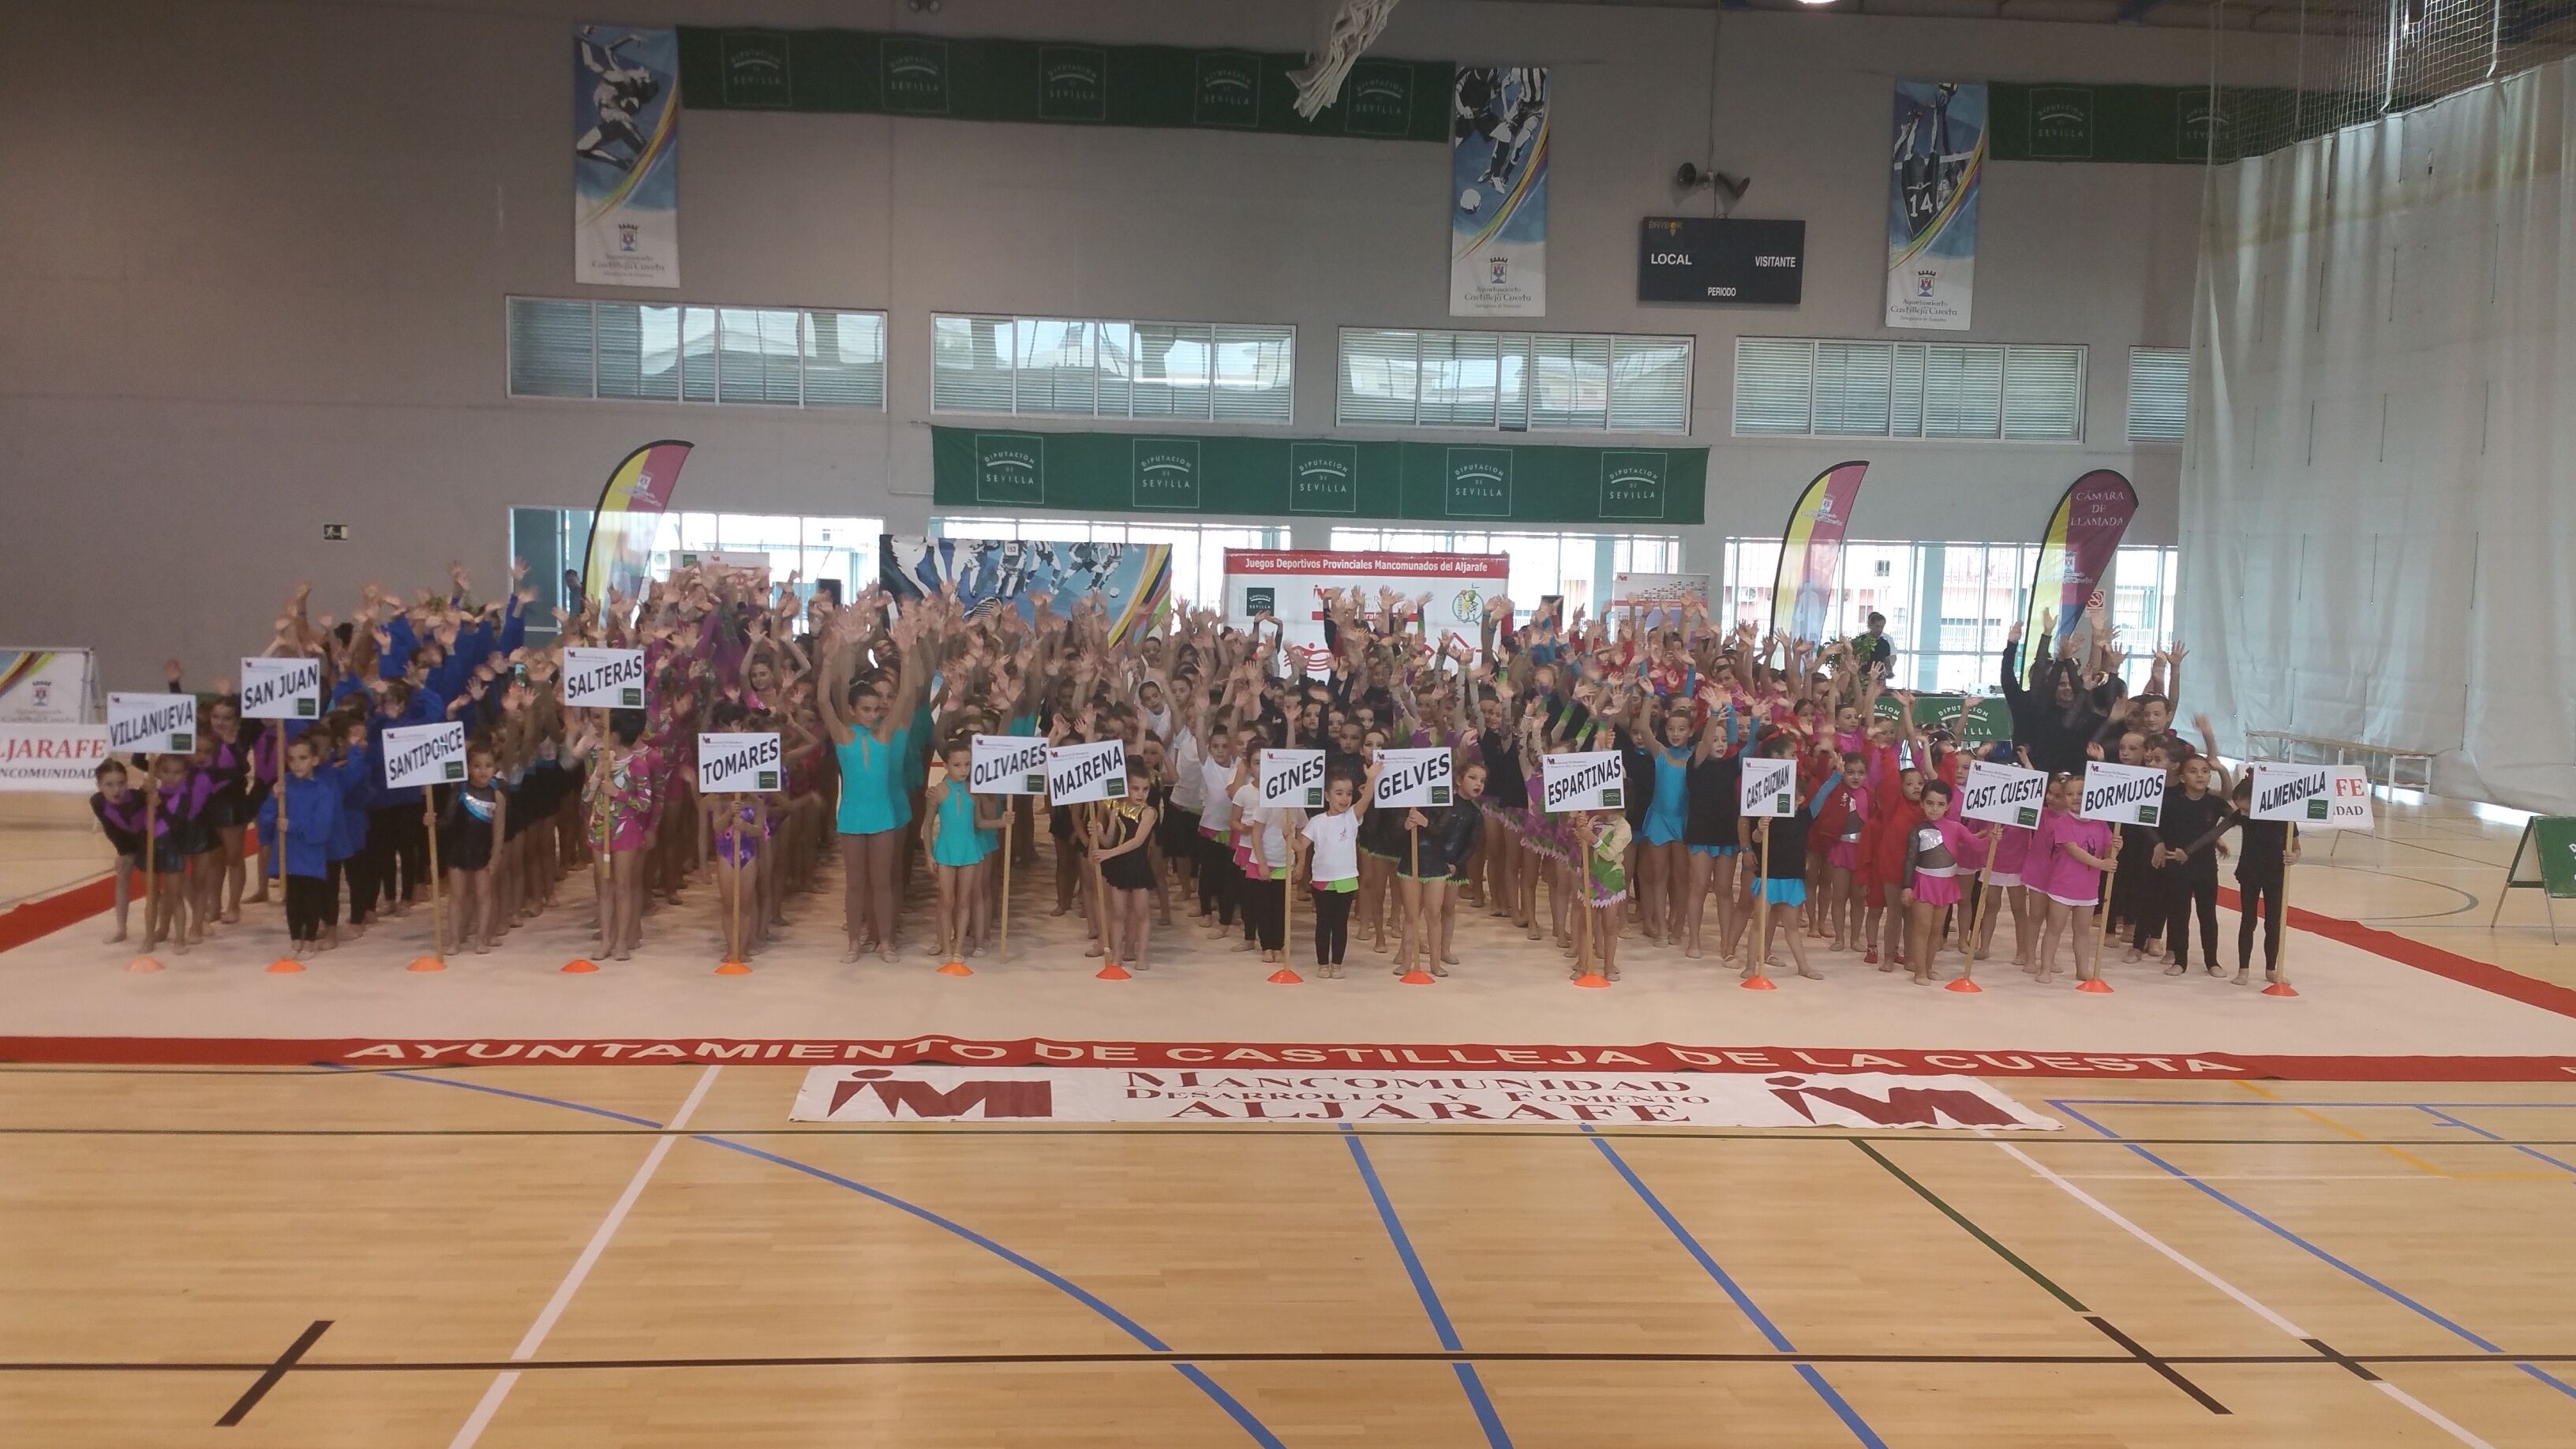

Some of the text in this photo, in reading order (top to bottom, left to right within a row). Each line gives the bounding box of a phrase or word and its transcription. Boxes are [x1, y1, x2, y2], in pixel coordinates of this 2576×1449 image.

[1355, 103, 1401, 114] SEVILLA
[2038, 129, 2084, 138] SEVILLA
[1908, 193, 1934, 219] 14
[1650, 253, 1692, 265] LOCAL
[1755, 256, 1796, 268] VISITANTE
[1464, 293, 1531, 302] Castilleja Cuesta
[1707, 286, 1736, 298] PERIODO
[1890, 305, 1957, 316] Castilleja Cuesta
[987, 474, 1034, 485] SEVILLA
[1143, 479, 1190, 489] SEVILLA
[1300, 483, 1347, 493] SEVILLA
[1455, 487, 1502, 498] SEVILLA
[1610, 491, 1656, 500] SEVILLA
[2092, 504, 2106, 514] DE
[2070, 517, 2124, 526] LLAMADA
[1245, 558, 1488, 573] Juegos Deportivos Provinciales Mancomunados del Aljarafe
[245, 664, 317, 710] SAN JUAN
[567, 655, 642, 699] SALTERAS
[110, 700, 193, 747] VILLANUEVA
[0, 739, 107, 763] JARAFE
[702, 738, 778, 784] TOMARES
[974, 743, 1047, 786] OLIVARES
[1053, 746, 1123, 800] MAIRENA
[1266, 755, 1324, 800] GINES
[1378, 753, 1451, 800] GELVES
[1548, 755, 1621, 806] ESPARTINAS
[1764, 764, 1790, 799] GUZMAN
[1966, 777, 2044, 811] CAST. CUESTA
[2084, 774, 2164, 812] BORMUJOS
[2259, 771, 2326, 814] ALMENSILLA
[344, 1039, 2248, 1073] AYUNTAMIENTO DE CASTILLEJA DE LA CUESTA
[1166, 1100, 1692, 1122] ALJARAFE
